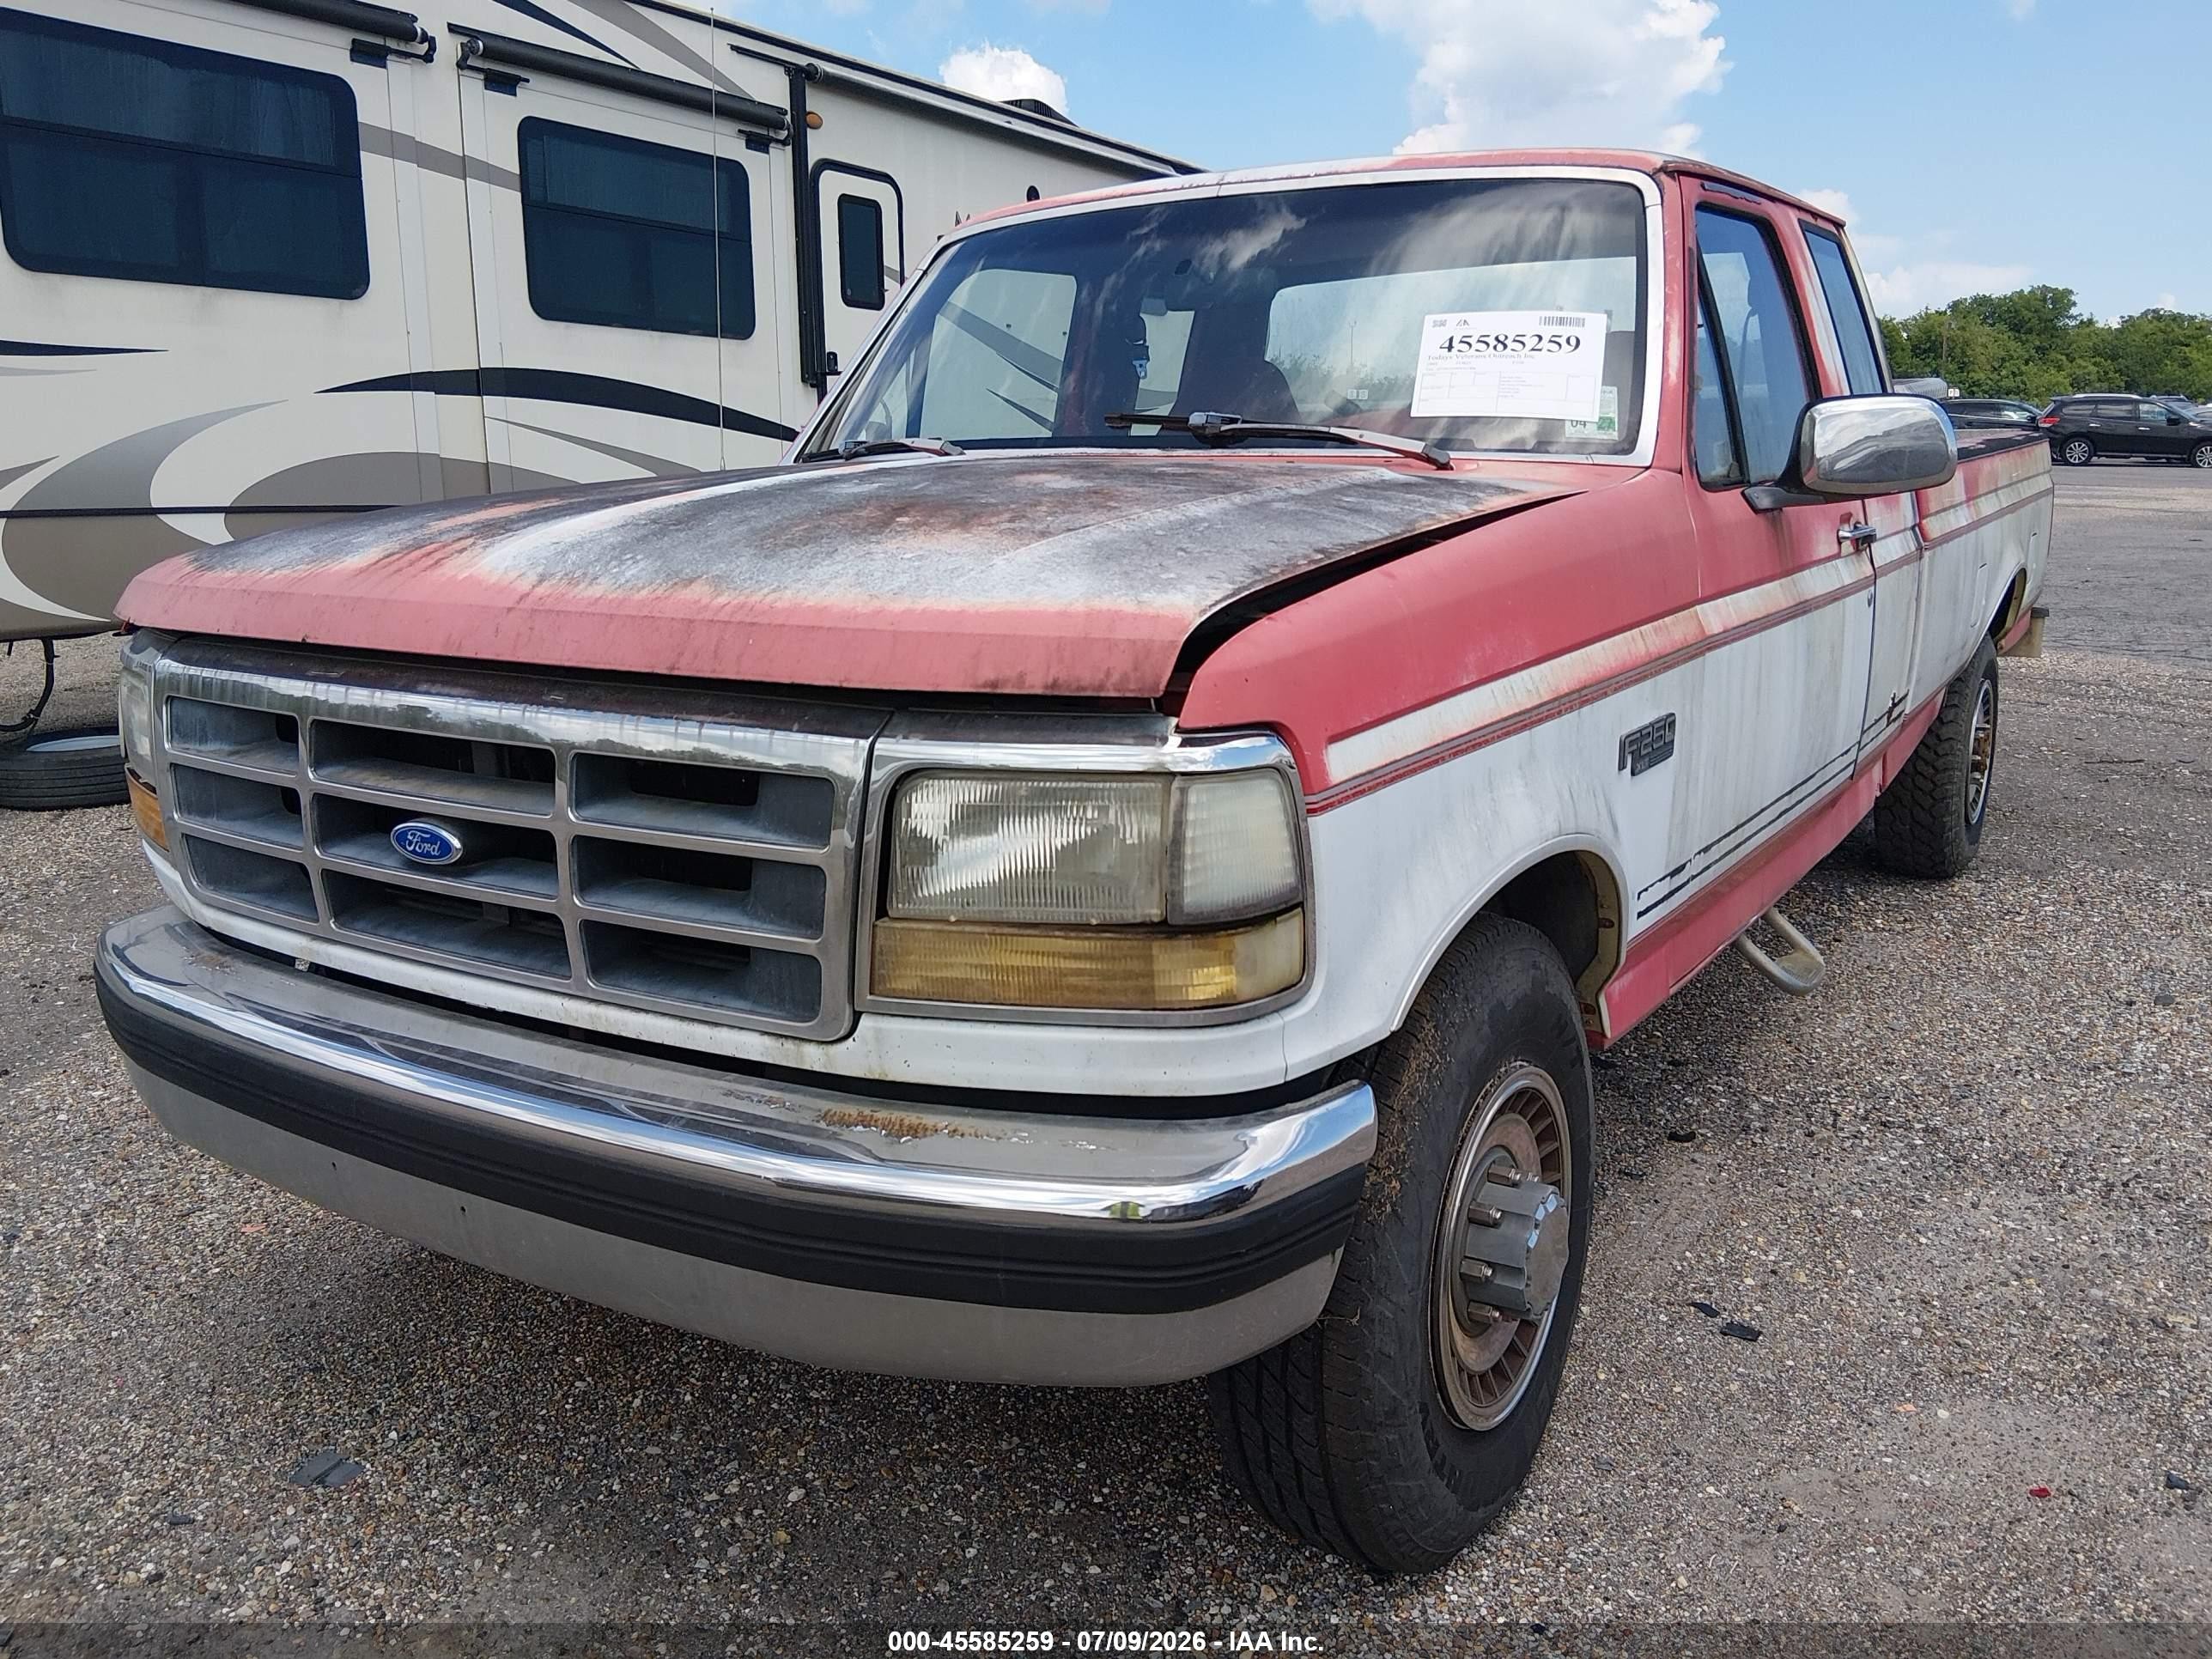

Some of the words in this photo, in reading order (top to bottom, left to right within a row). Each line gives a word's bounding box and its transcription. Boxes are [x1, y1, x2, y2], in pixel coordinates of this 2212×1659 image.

[1439, 333, 1581, 354] 45585259
[1619, 714, 1676, 770] F250
[405, 830, 441, 856] Ford
